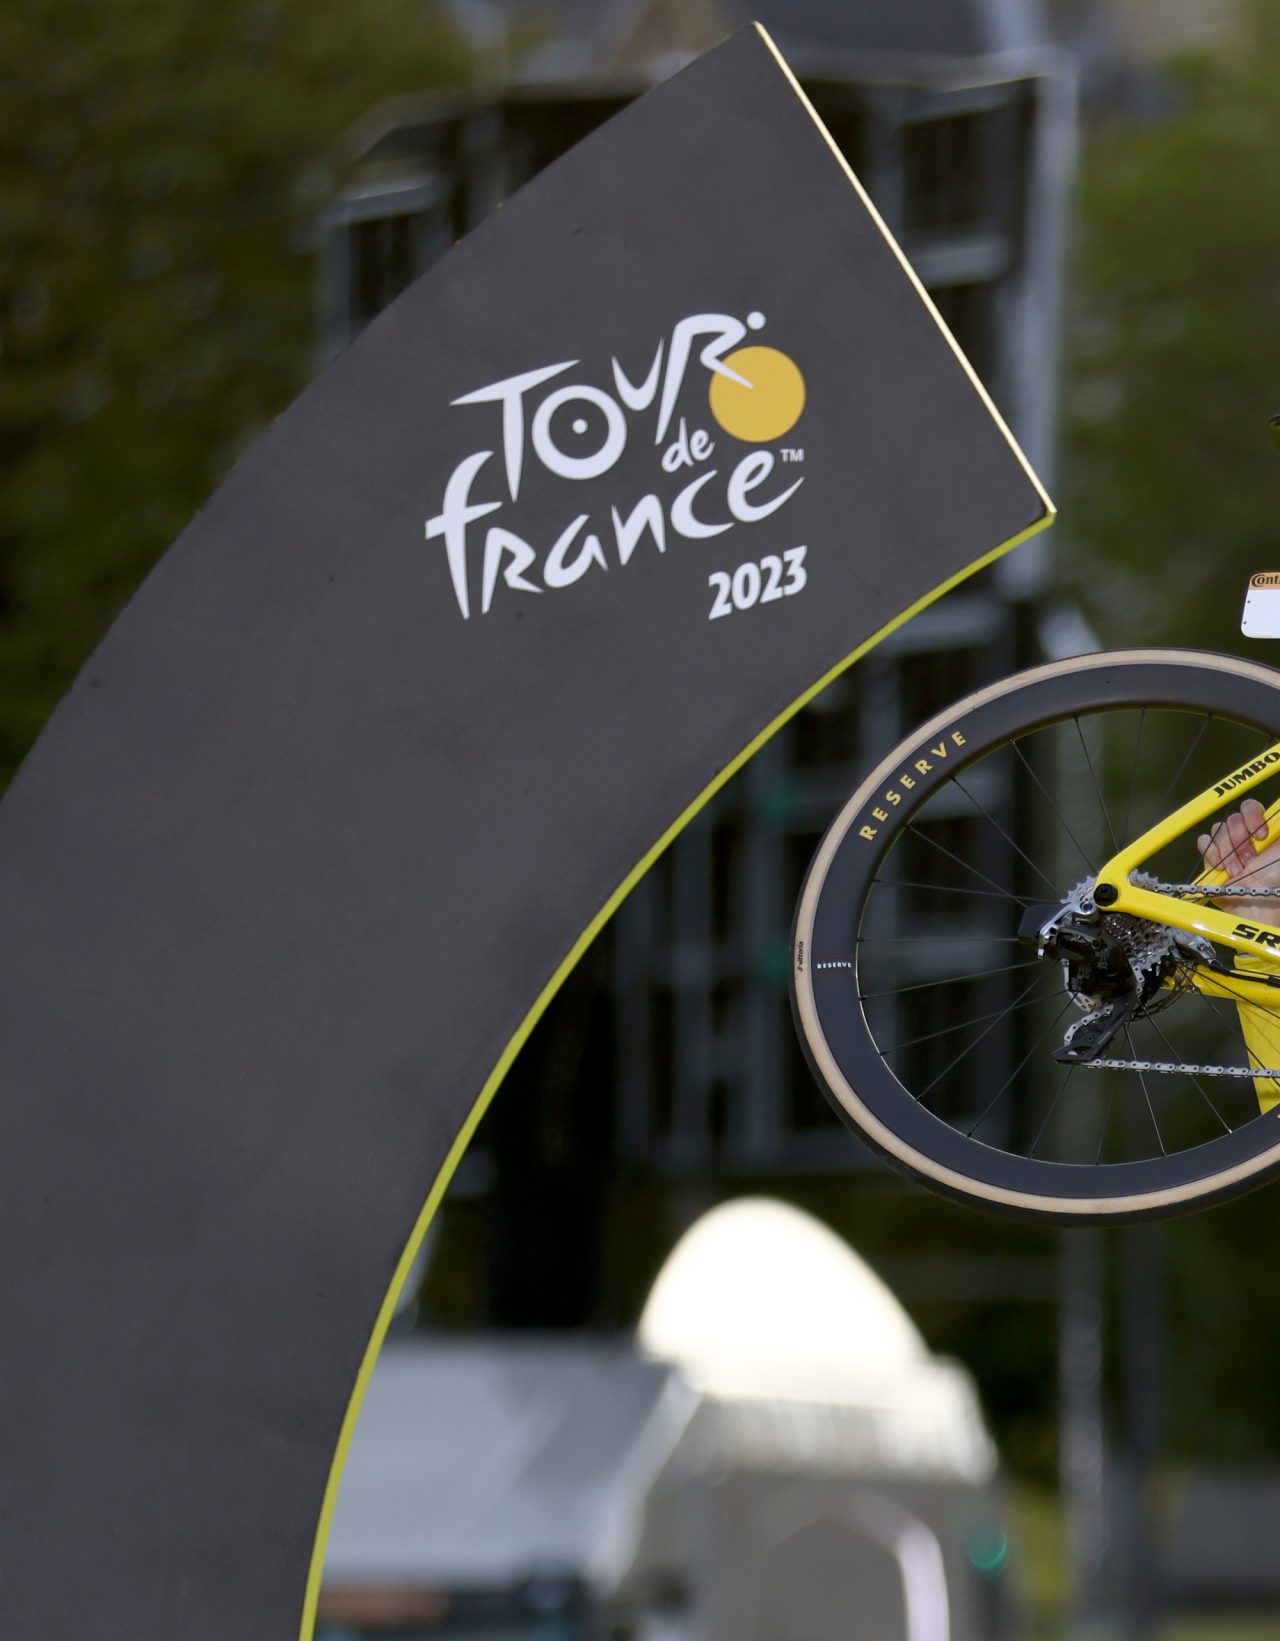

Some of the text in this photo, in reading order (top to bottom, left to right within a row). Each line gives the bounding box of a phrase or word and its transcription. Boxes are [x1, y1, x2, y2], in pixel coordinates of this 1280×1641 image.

[661, 417, 715, 473] de
[707, 545, 808, 621] 2023
[858, 731, 967, 841] RESERVE
[1213, 751, 1280, 798] JUMBO
[816, 961, 852, 969] RESERVE
